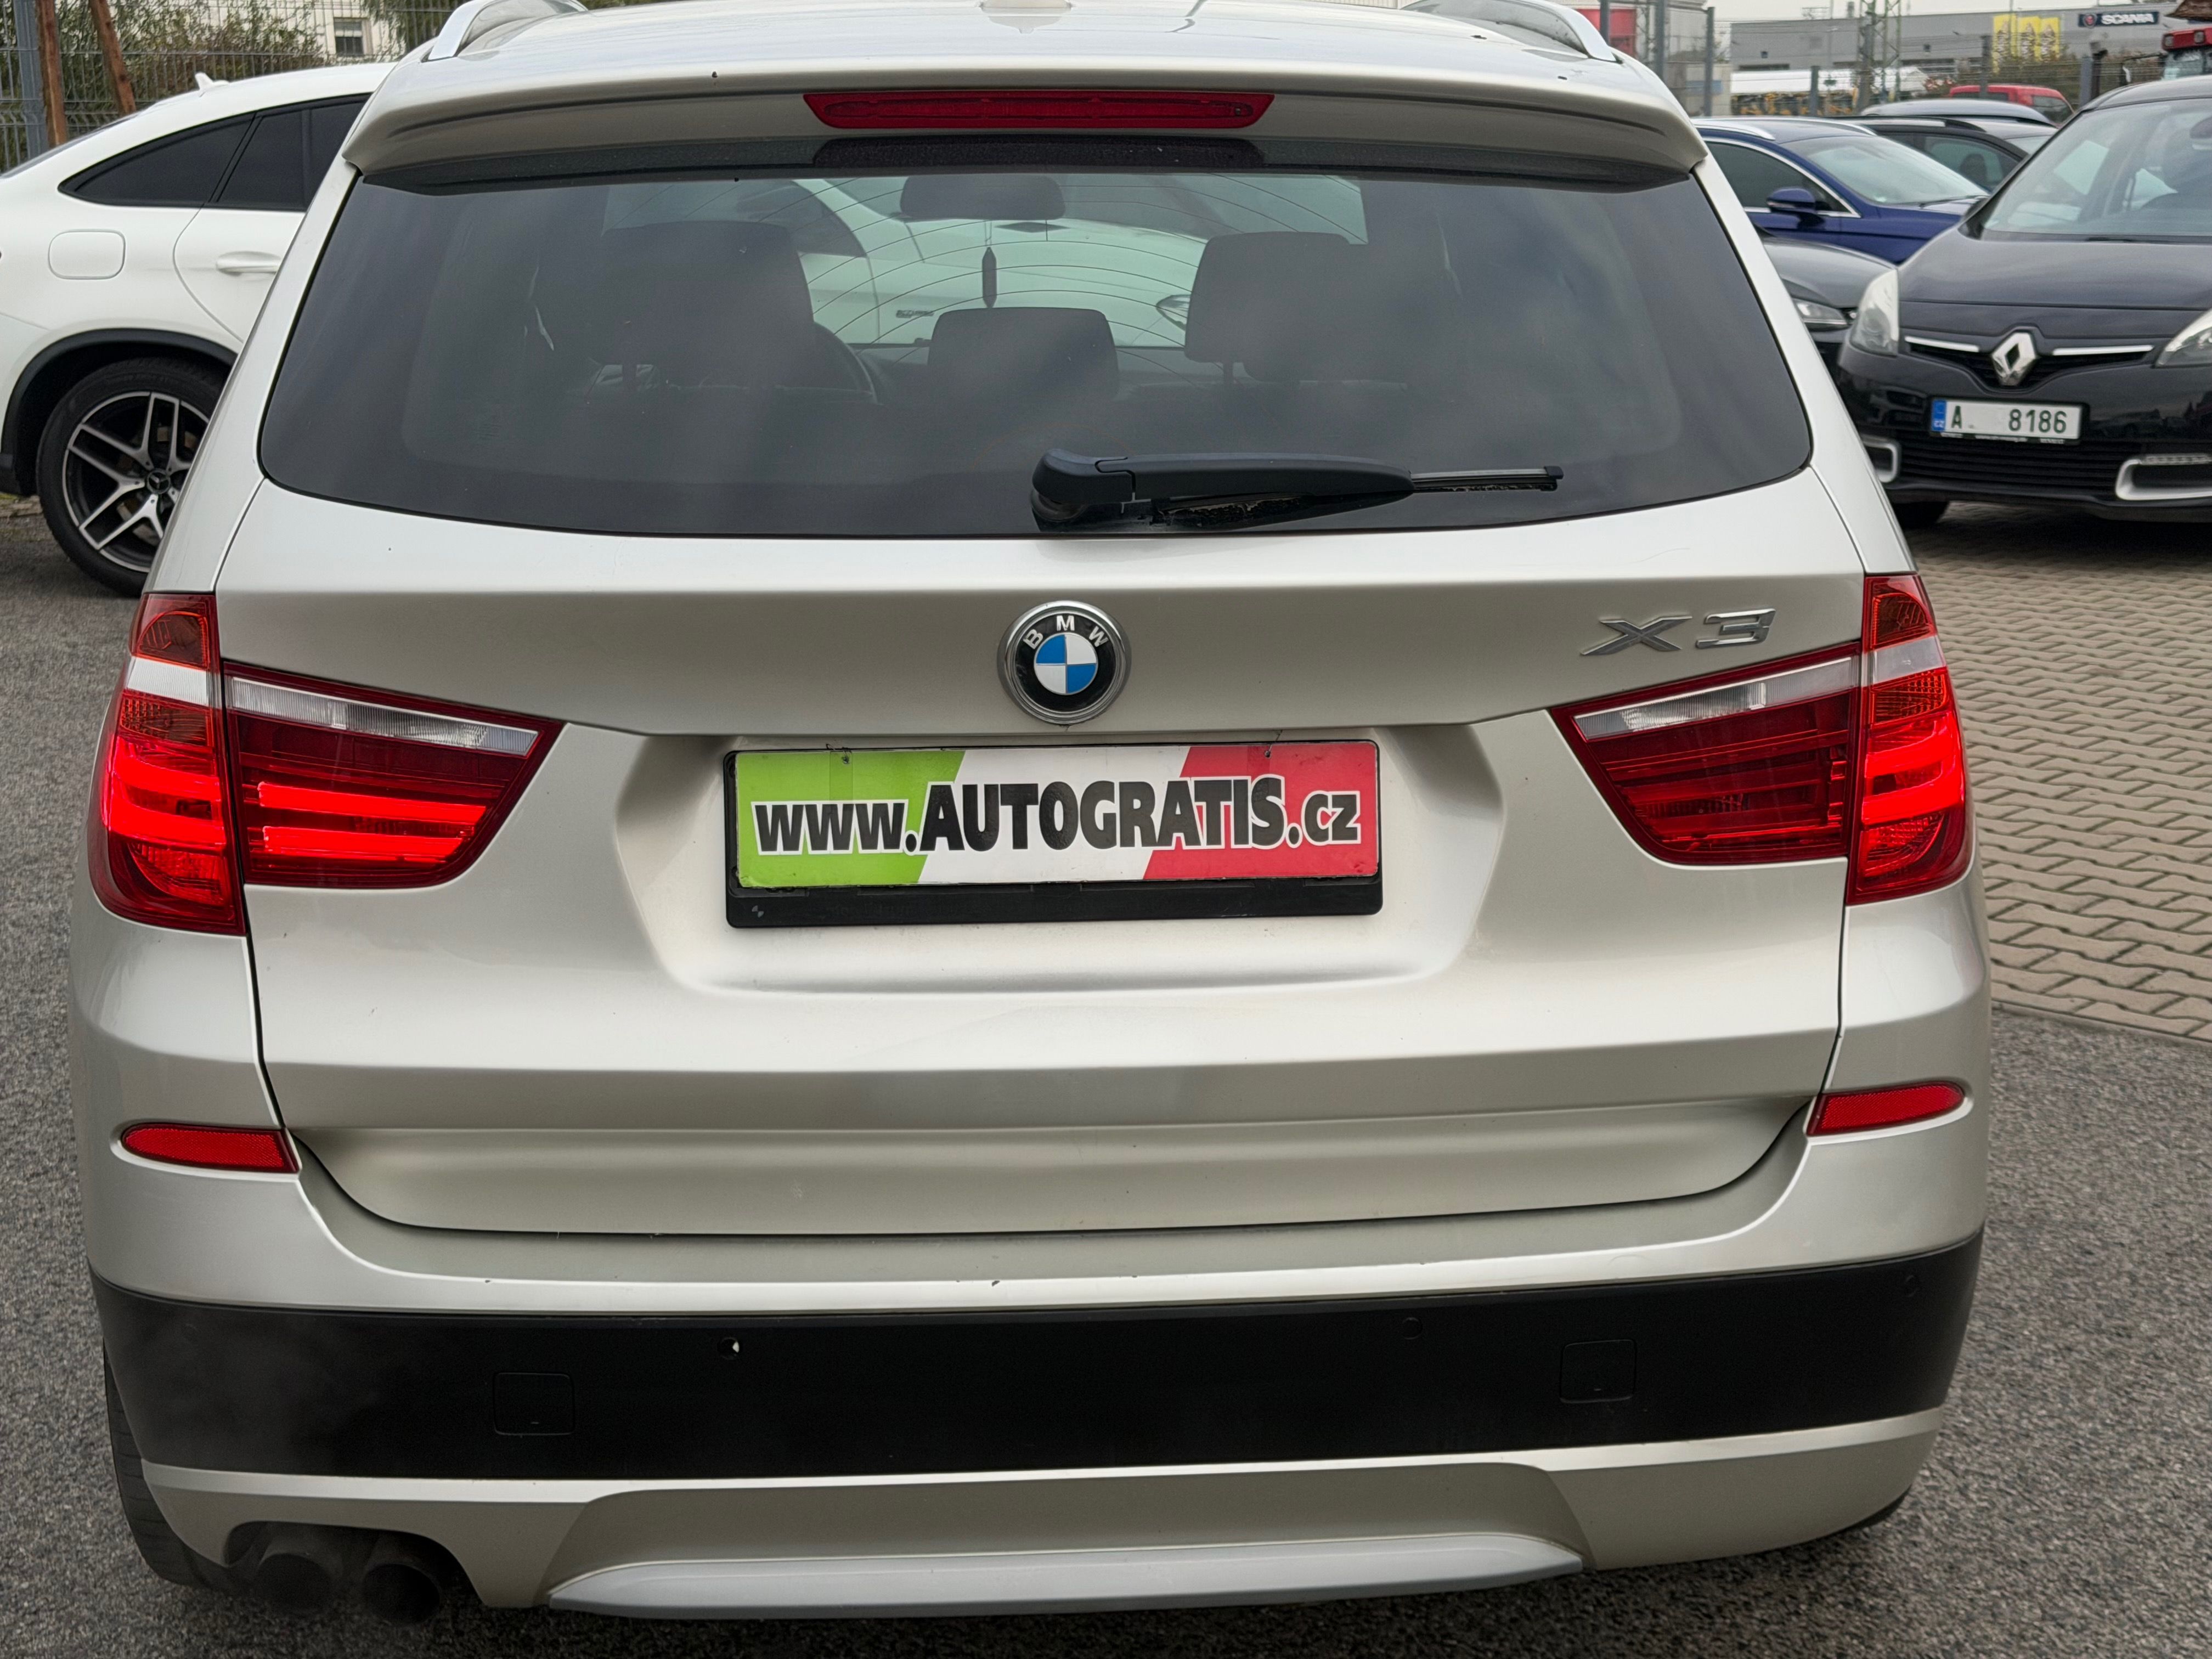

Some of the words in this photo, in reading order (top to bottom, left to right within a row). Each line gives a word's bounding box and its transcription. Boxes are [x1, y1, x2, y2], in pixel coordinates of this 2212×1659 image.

[2101, 13, 2155, 25] SCANIA
[1951, 405, 1962, 429] A
[2008, 408, 2067, 434] 8186
[1023, 614, 1098, 650] BMW
[1580, 607, 1776, 656] X3
